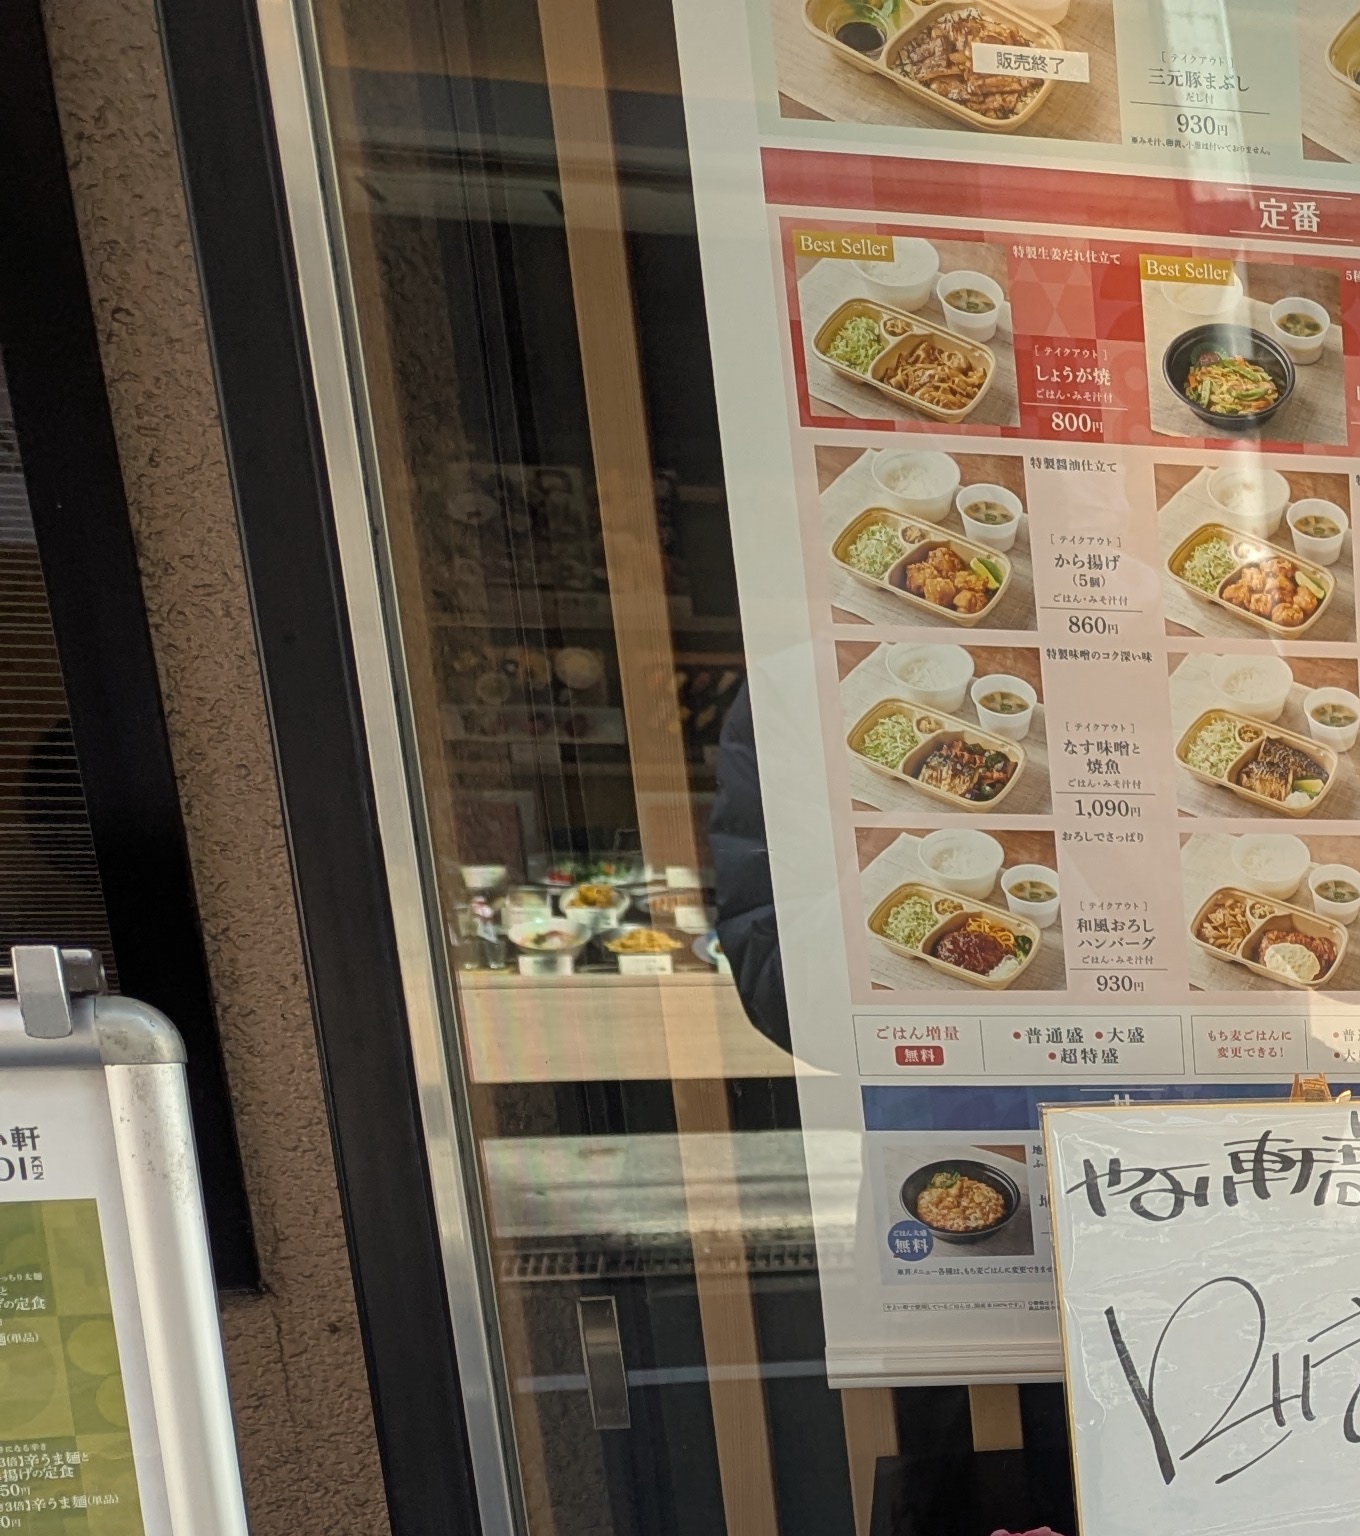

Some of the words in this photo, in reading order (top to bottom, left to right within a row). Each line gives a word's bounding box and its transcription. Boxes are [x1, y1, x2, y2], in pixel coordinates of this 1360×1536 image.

[996, 51, 1066, 75] 販売終了
[1148, 68, 1250, 93] 三元豚まぶし
[1176, 112, 1228, 137] 930円
[1258, 199, 1320, 233] 定番
[800, 235, 835, 254] Best
[840, 238, 888, 257] Seller
[1013, 245, 1121, 266] 特製生姜だれ仕立て
[1146, 260, 1182, 279] Best
[1186, 262, 1229, 281] Seller
[1036, 366, 1110, 387] しょうが焼
[1051, 411, 1103, 434] 800円
[1030, 456, 1118, 473] 特製醤油仕立て
[1055, 553, 1120, 571] から揚げ
[1068, 615, 1118, 635] 860円
[1046, 648, 1153, 664] 特製味噌のコク深い味
[1064, 739, 1141, 756] なす味噌と
[1086, 758, 1120, 775] 焼魚
[1075, 799, 1140, 819] 1,090円
[1062, 830, 1145, 844] おろしでさっぱり
[1077, 917, 1155, 934] 和風おろし
[1077, 936, 1156, 951] ハンバーグ
[1096, 974, 1144, 993] 930円
[876, 1025, 960, 1042] ごはん増量
[1025, 1027, 1084, 1045] 普通盛
[1108, 1027, 1145, 1044] 大盛
[1207, 1029, 1292, 1042] もち麦ごはんに
[904, 1048, 935, 1064] 無料
[1060, 1047, 1119, 1065] 超特盛
[1217, 1045, 1285, 1060] 変更できる!
[895, 1239, 928, 1255] 無料
